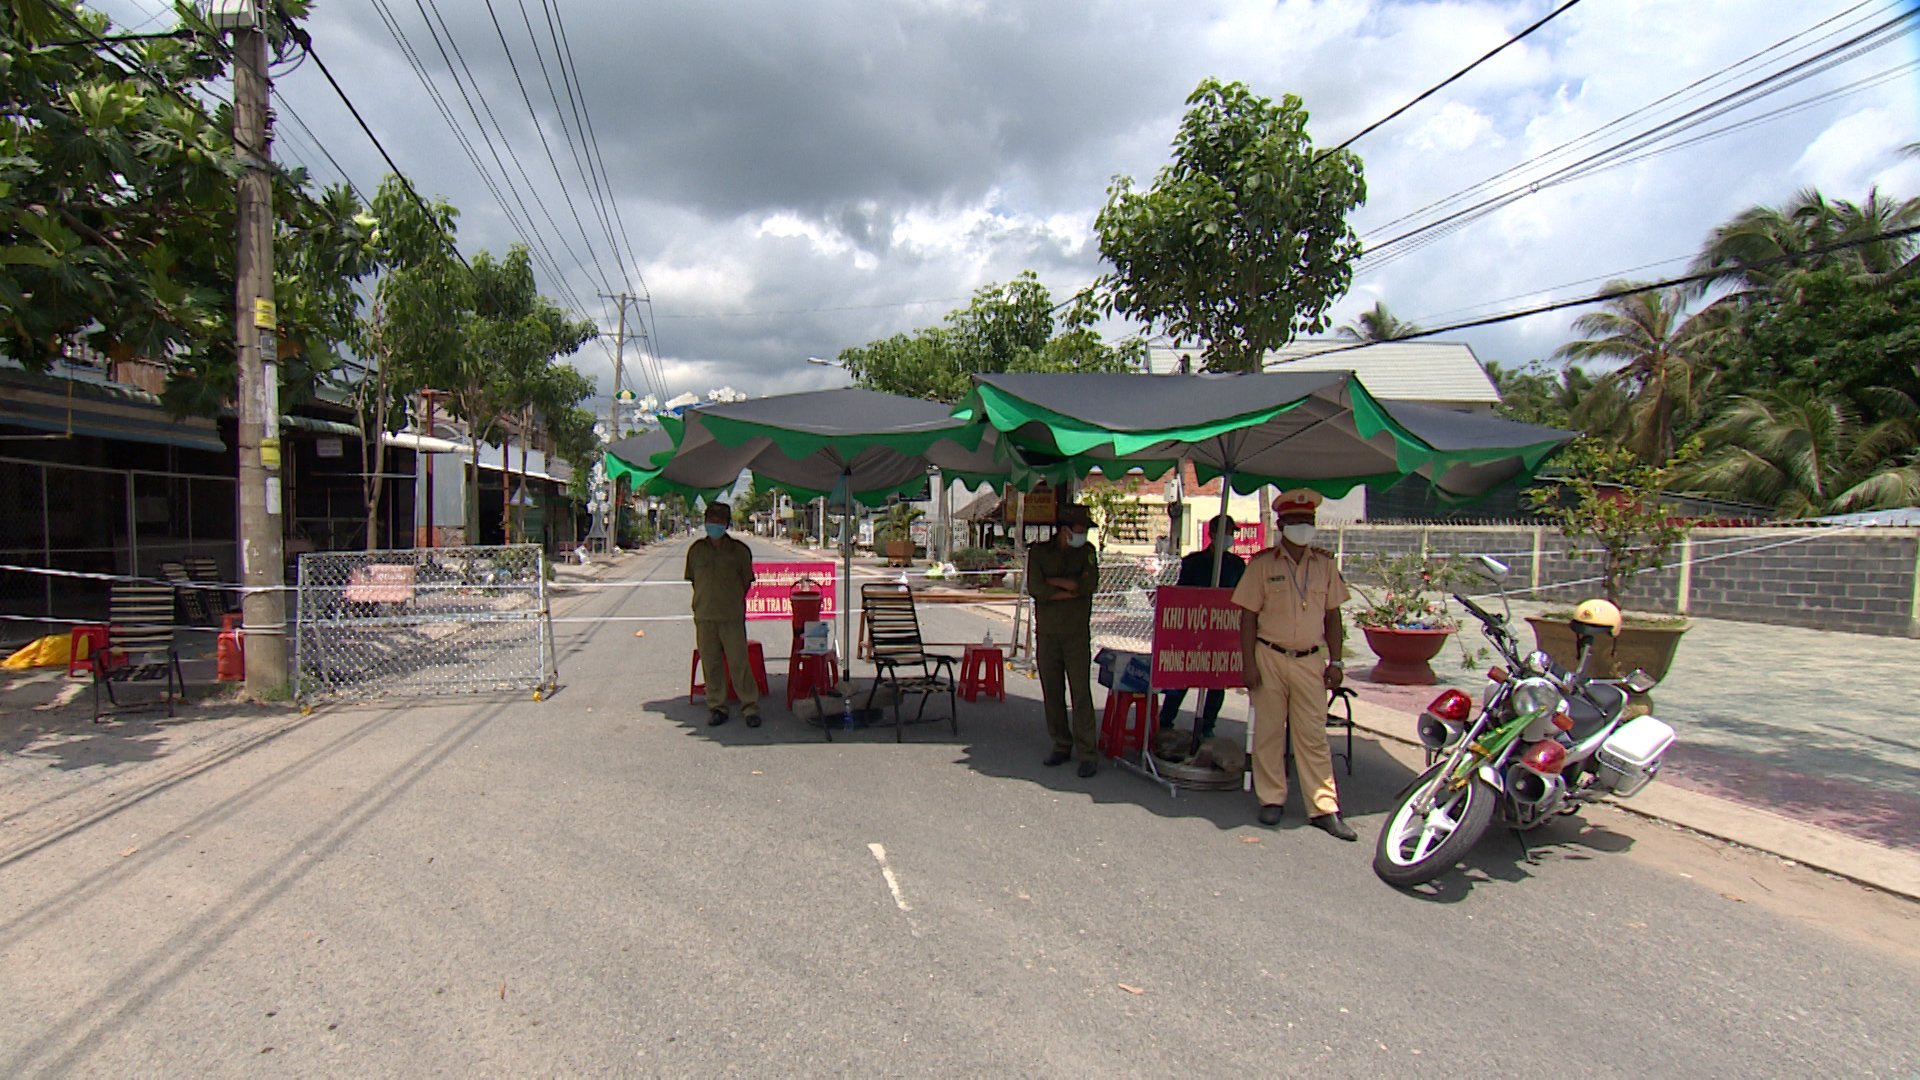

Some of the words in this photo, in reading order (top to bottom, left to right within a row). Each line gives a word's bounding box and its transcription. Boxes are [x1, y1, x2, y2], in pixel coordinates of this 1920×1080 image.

[746, 591, 765, 612] KIỂM
[766, 598, 781, 612] TRA
[1162, 607, 1185, 630] KHU
[1187, 603, 1208, 634] VỰC
[1158, 643, 1185, 672] PHÒNG
[1185, 641, 1211, 672] CHỐNG
[1211, 651, 1229, 678] DỊCH
